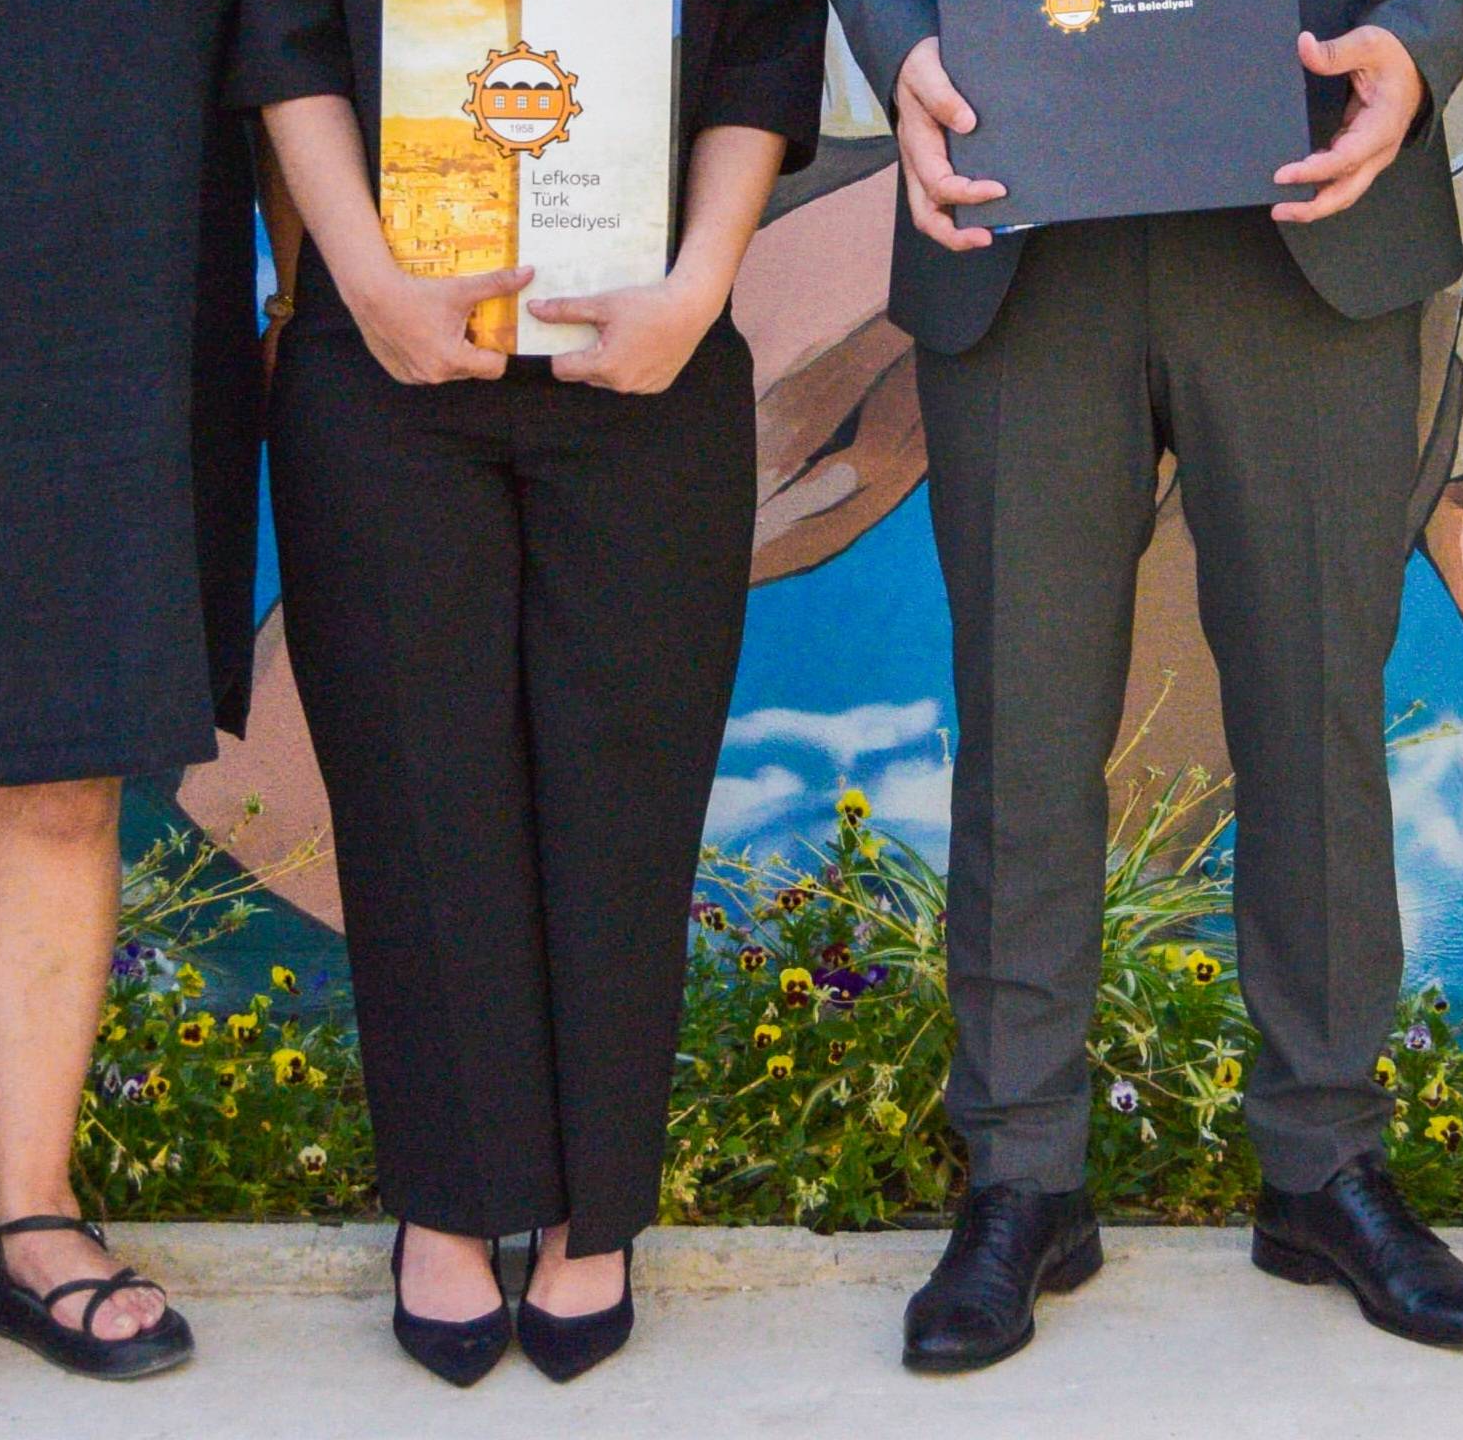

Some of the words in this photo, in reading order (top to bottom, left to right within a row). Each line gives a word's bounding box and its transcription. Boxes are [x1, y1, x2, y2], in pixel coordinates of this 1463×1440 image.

[1111, 3, 1136, 14] Türk
[509, 123, 535, 134] 1958
[531, 169, 601, 188] Lefkoşa
[531, 191, 570, 207] Türk
[531, 212, 621, 232] Belediyesi
